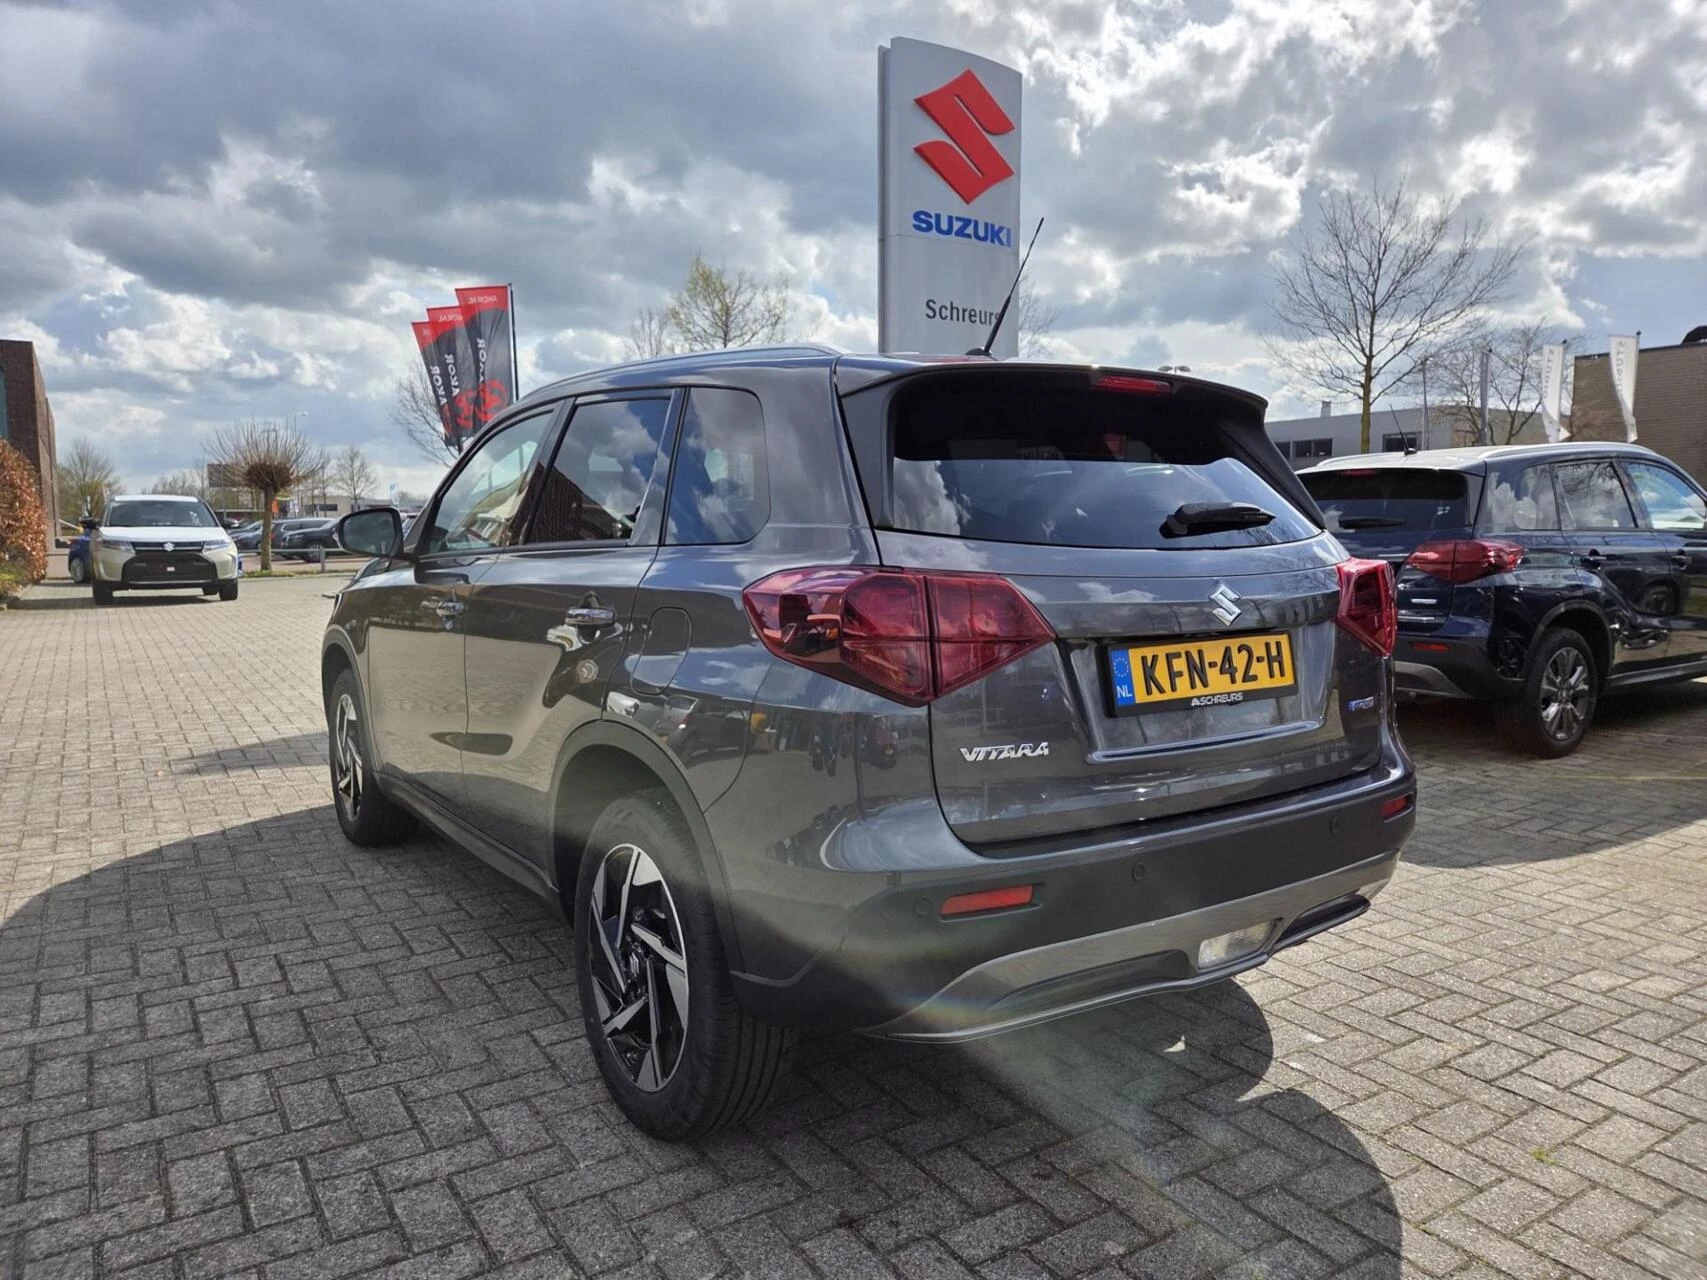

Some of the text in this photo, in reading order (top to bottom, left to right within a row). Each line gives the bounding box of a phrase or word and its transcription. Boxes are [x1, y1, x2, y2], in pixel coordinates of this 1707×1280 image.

[912, 209, 1012, 248] SUZUKI
[1140, 640, 1287, 697] KFN-42-H
[1116, 684, 1133, 698] NL
[1200, 692, 1244, 706] SCHREURS
[960, 741, 1049, 762] VITARA
